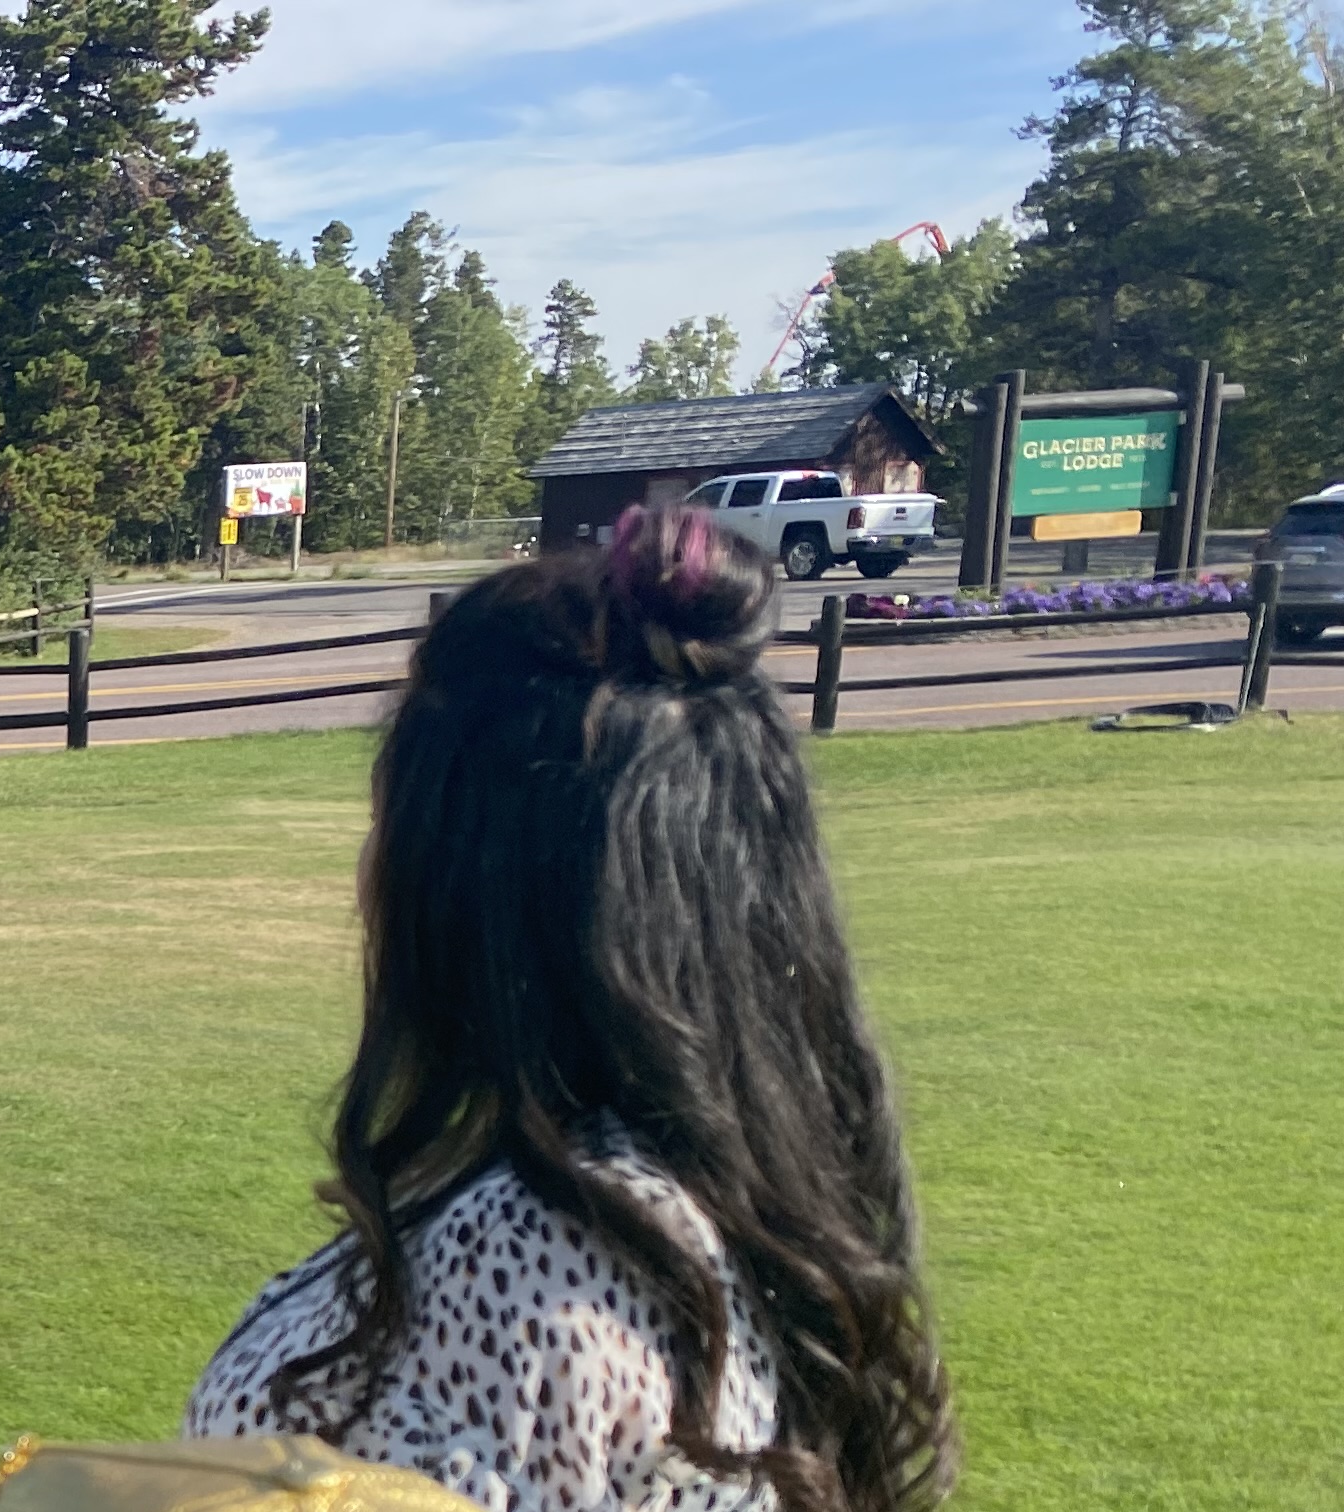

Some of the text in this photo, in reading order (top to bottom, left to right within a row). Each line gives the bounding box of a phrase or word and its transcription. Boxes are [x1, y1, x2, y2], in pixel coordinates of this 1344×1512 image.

[1023, 437, 1106, 459] GLACIER
[1111, 433, 1167, 450] PARK
[1063, 452, 1125, 471] LODGE
[233, 466, 302, 480] SLOW DOWN
